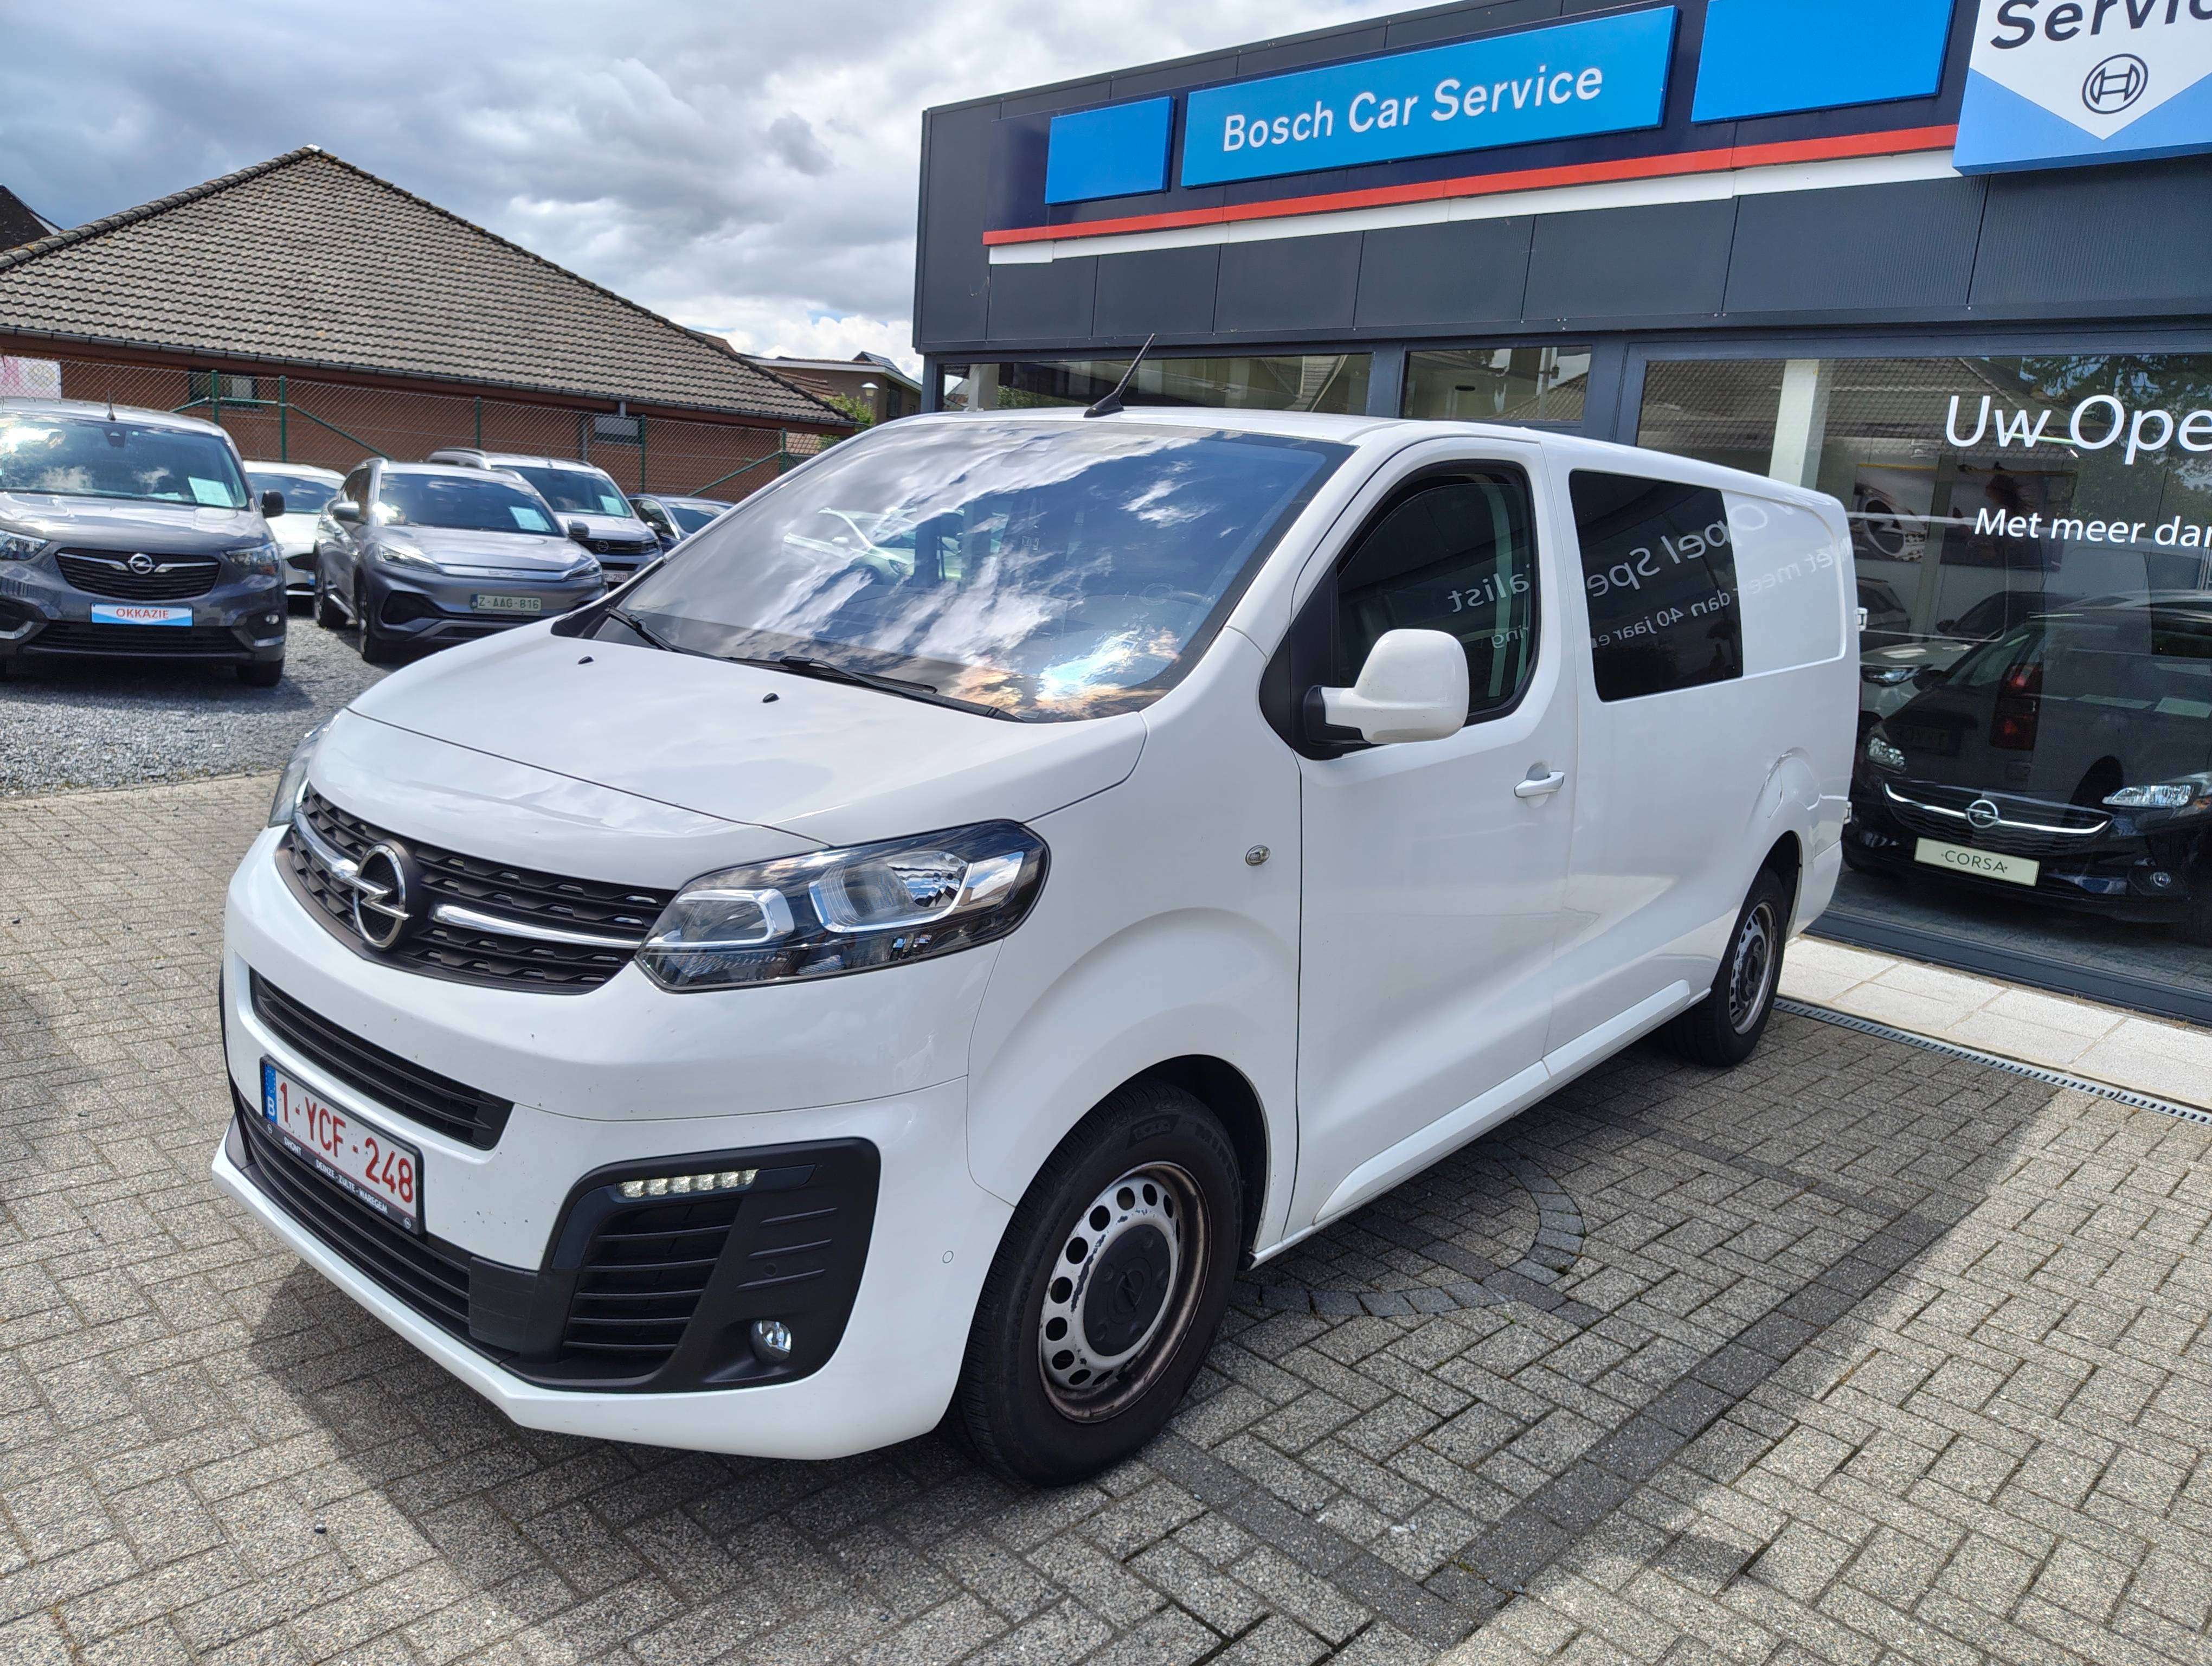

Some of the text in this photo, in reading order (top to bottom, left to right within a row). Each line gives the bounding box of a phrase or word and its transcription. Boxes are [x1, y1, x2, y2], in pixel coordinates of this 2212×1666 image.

[1223, 65, 1603, 152] Bosch Car Service
[1945, 394, 2212, 465] Uw Ope
[1973, 508, 2041, 539] Met
[2050, 519, 2146, 544] meer
[116, 608, 169, 619] OKKAZIE
[1945, 850, 2005, 873] CORSA
[267, 1096, 275, 1116] B
